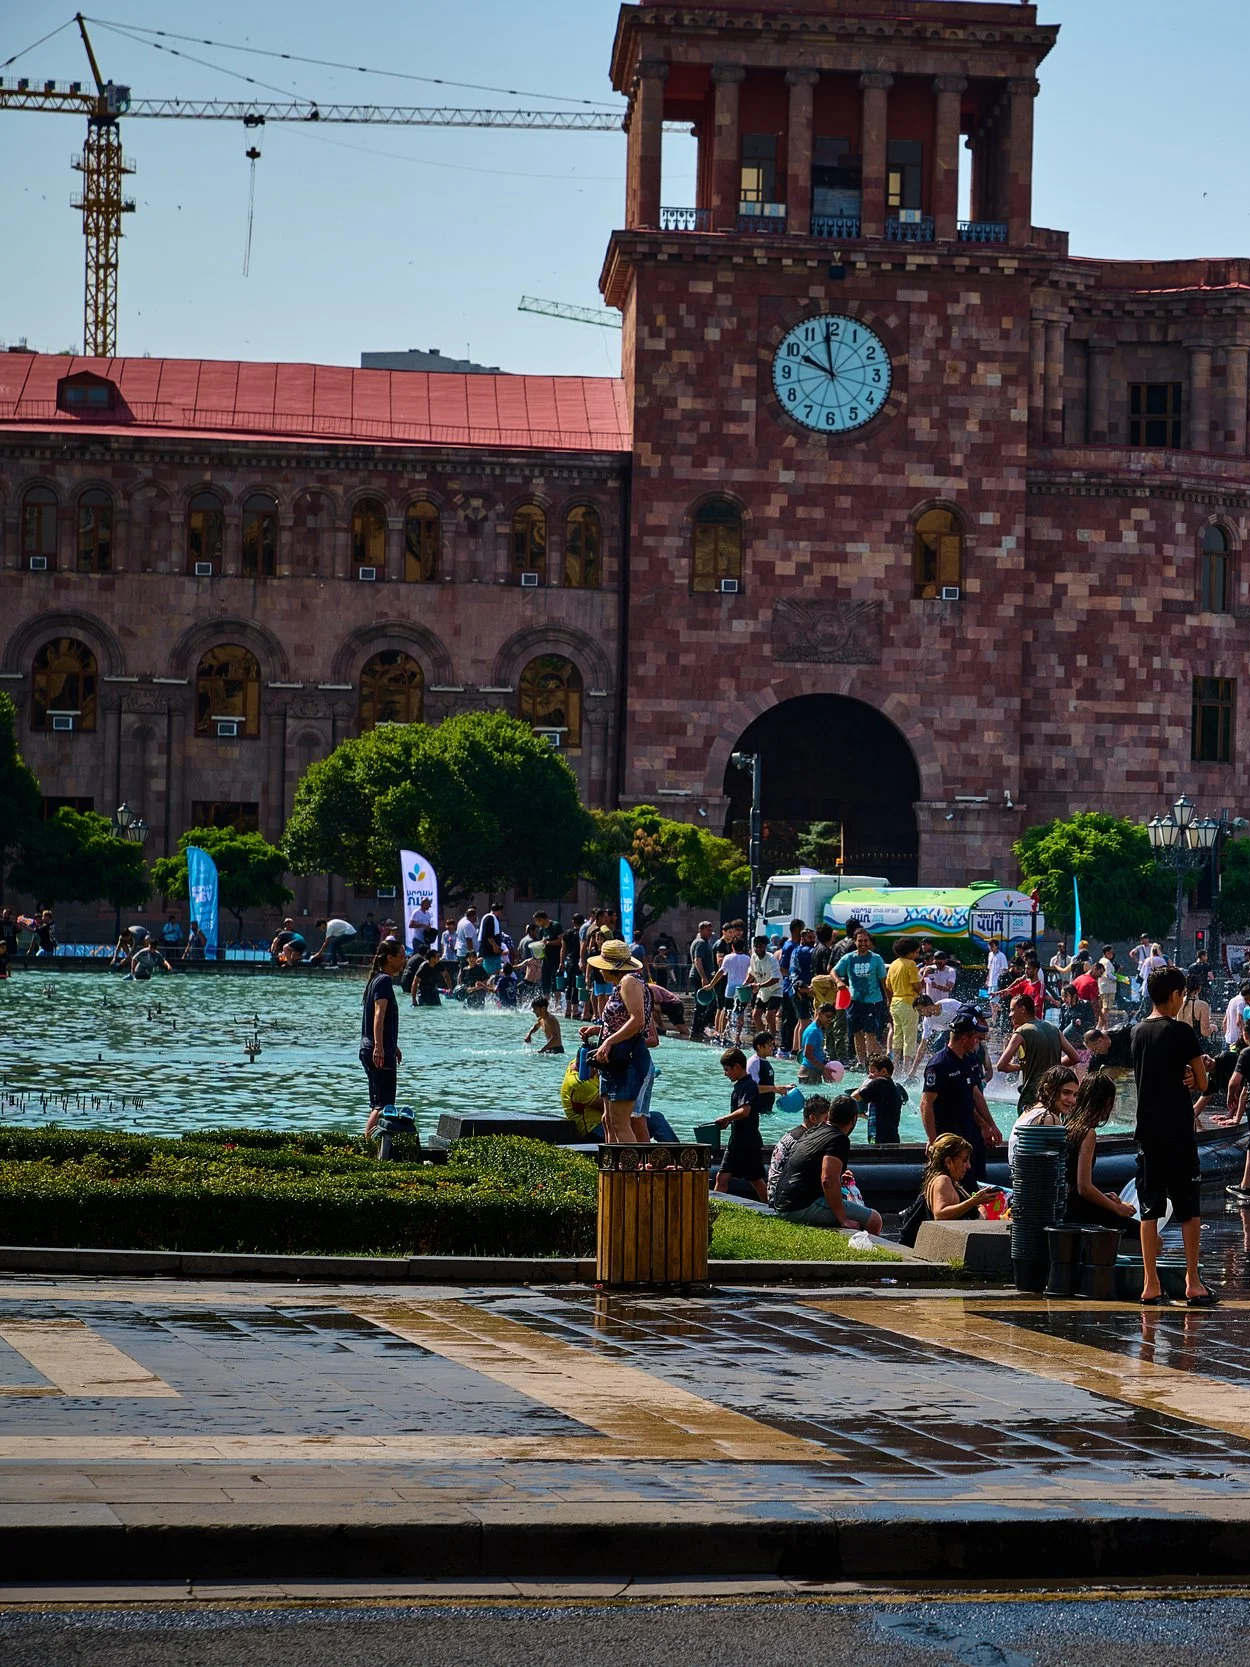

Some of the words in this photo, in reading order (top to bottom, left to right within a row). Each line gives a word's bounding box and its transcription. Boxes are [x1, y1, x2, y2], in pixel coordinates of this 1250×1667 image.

[804, 327, 815, 341] 11
[852, 329, 857, 343] 1
[786, 343, 800, 357] 10
[866, 346, 876, 360] 2
[782, 365, 791, 379] 9
[872, 369, 881, 383] 3
[788, 388, 796, 402] 8
[866, 391, 874, 405] 4
[804, 405, 813, 419] 7
[826, 412, 835, 426] 6
[849, 407, 858, 421] 5
